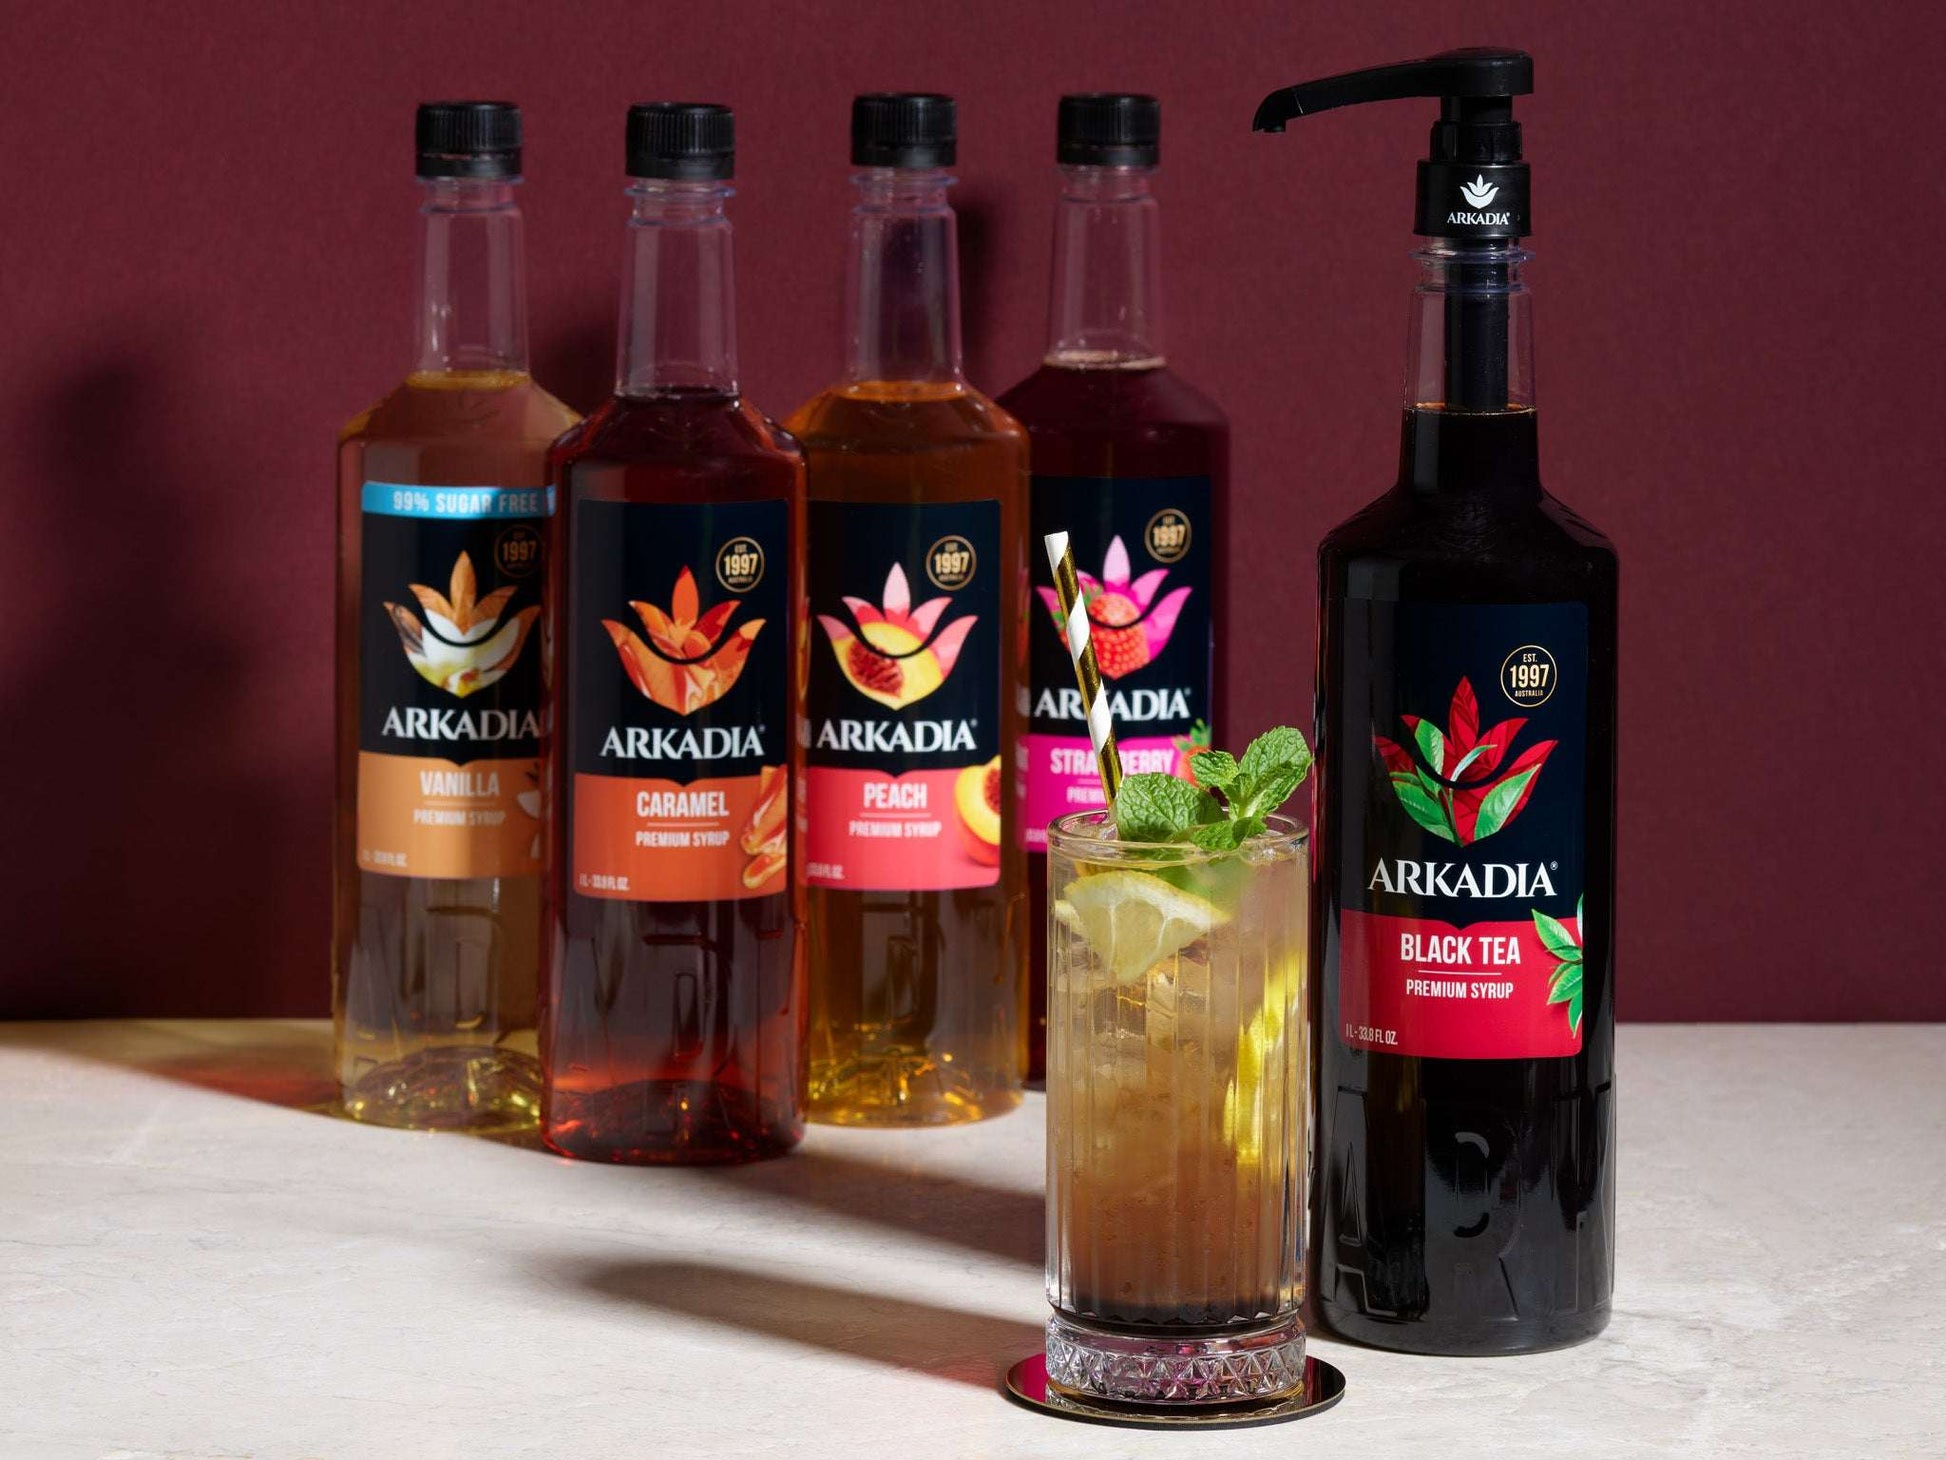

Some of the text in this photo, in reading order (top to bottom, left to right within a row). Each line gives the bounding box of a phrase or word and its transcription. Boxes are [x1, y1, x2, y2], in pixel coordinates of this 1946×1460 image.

[1446, 211, 1509, 225] ARKADIA
[393, 490, 538, 514] 99% SUGAR FREE
[502, 540, 537, 562] 1997
[933, 551, 970, 574] 1997
[723, 552, 758, 576] 1997
[1522, 653, 1538, 663] EST.
[1509, 663, 1550, 688] 1997
[1034, 688, 1191, 721] ARADIA
[1514, 689, 1544, 697] AUSTRALIA
[381, 706, 540, 741] ARKADIA
[816, 718, 977, 752] ARKADIA
[600, 726, 765, 760] ARKADIA
[1049, 747, 1174, 776] STRABERRY
[419, 770, 500, 797] VANILLA
[863, 782, 928, 809] PEACH
[636, 790, 730, 818] CARAMEL
[635, 830, 730, 847] PREMIUM SYRUP
[849, 820, 942, 838] PREMIUM SYRUP
[1367, 857, 1558, 898] ARKADIA
[1400, 933, 1521, 965] BLACK TEA
[1406, 979, 1514, 999] PREMIUM SYRUP
[1358, 1026, 1374, 1042] 33.8
[1375, 1028, 1384, 1043] FL
